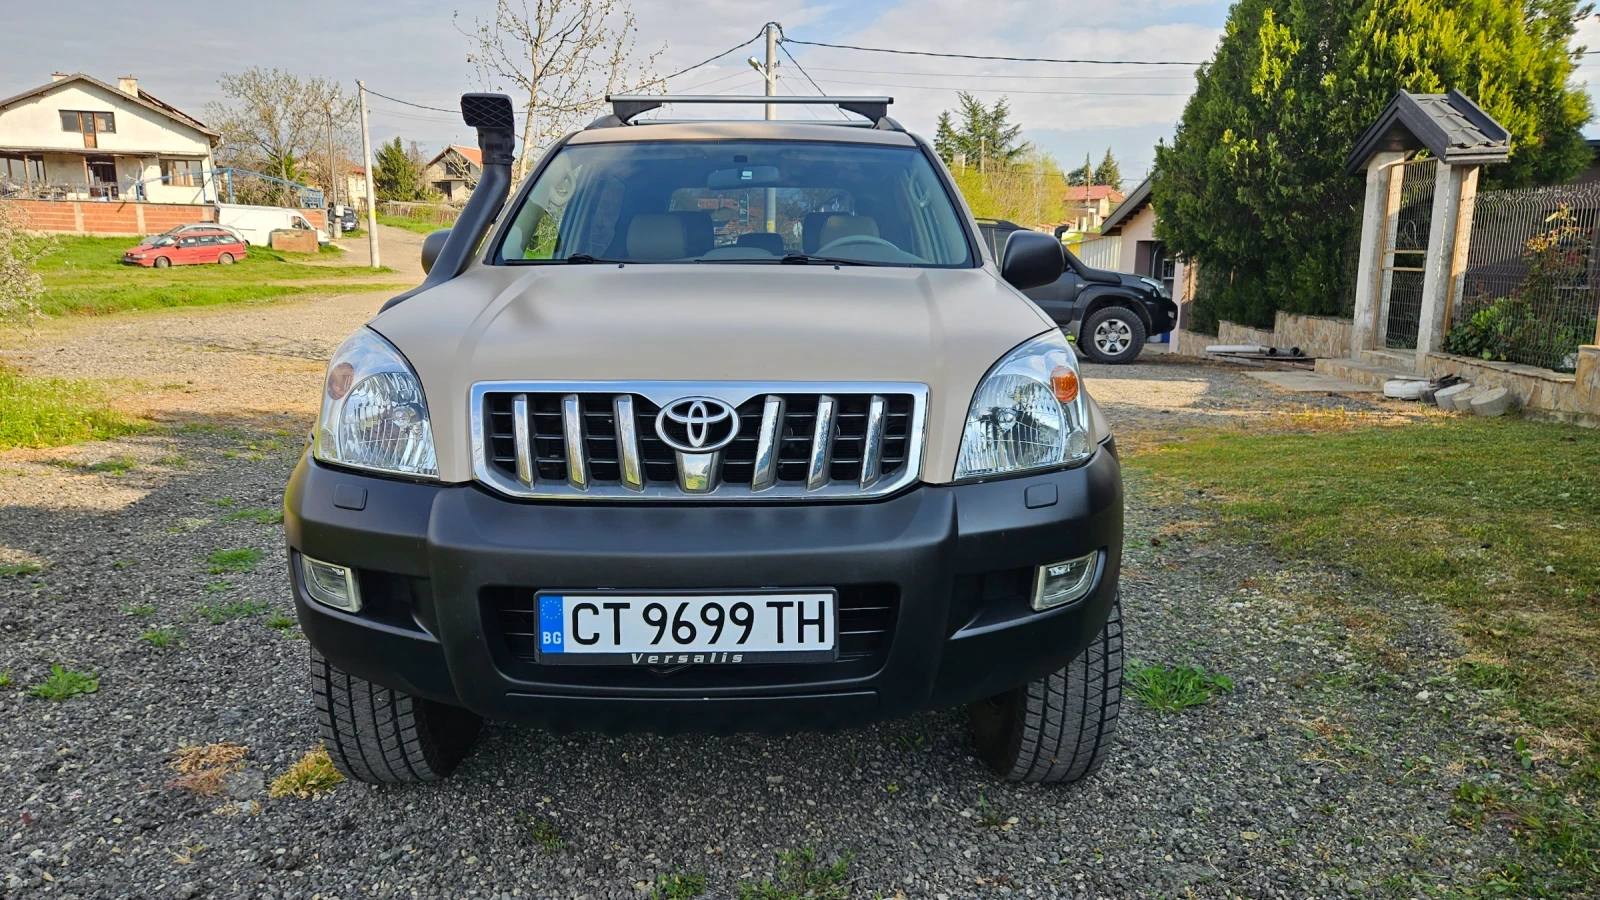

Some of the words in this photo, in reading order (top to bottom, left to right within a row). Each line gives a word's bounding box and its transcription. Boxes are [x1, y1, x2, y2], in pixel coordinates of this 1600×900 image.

[572, 602, 631, 646] CT
[642, 601, 755, 645] 9699
[766, 600, 826, 644] TH
[542, 631, 562, 645] BG
[631, 652, 744, 664] Versalis
